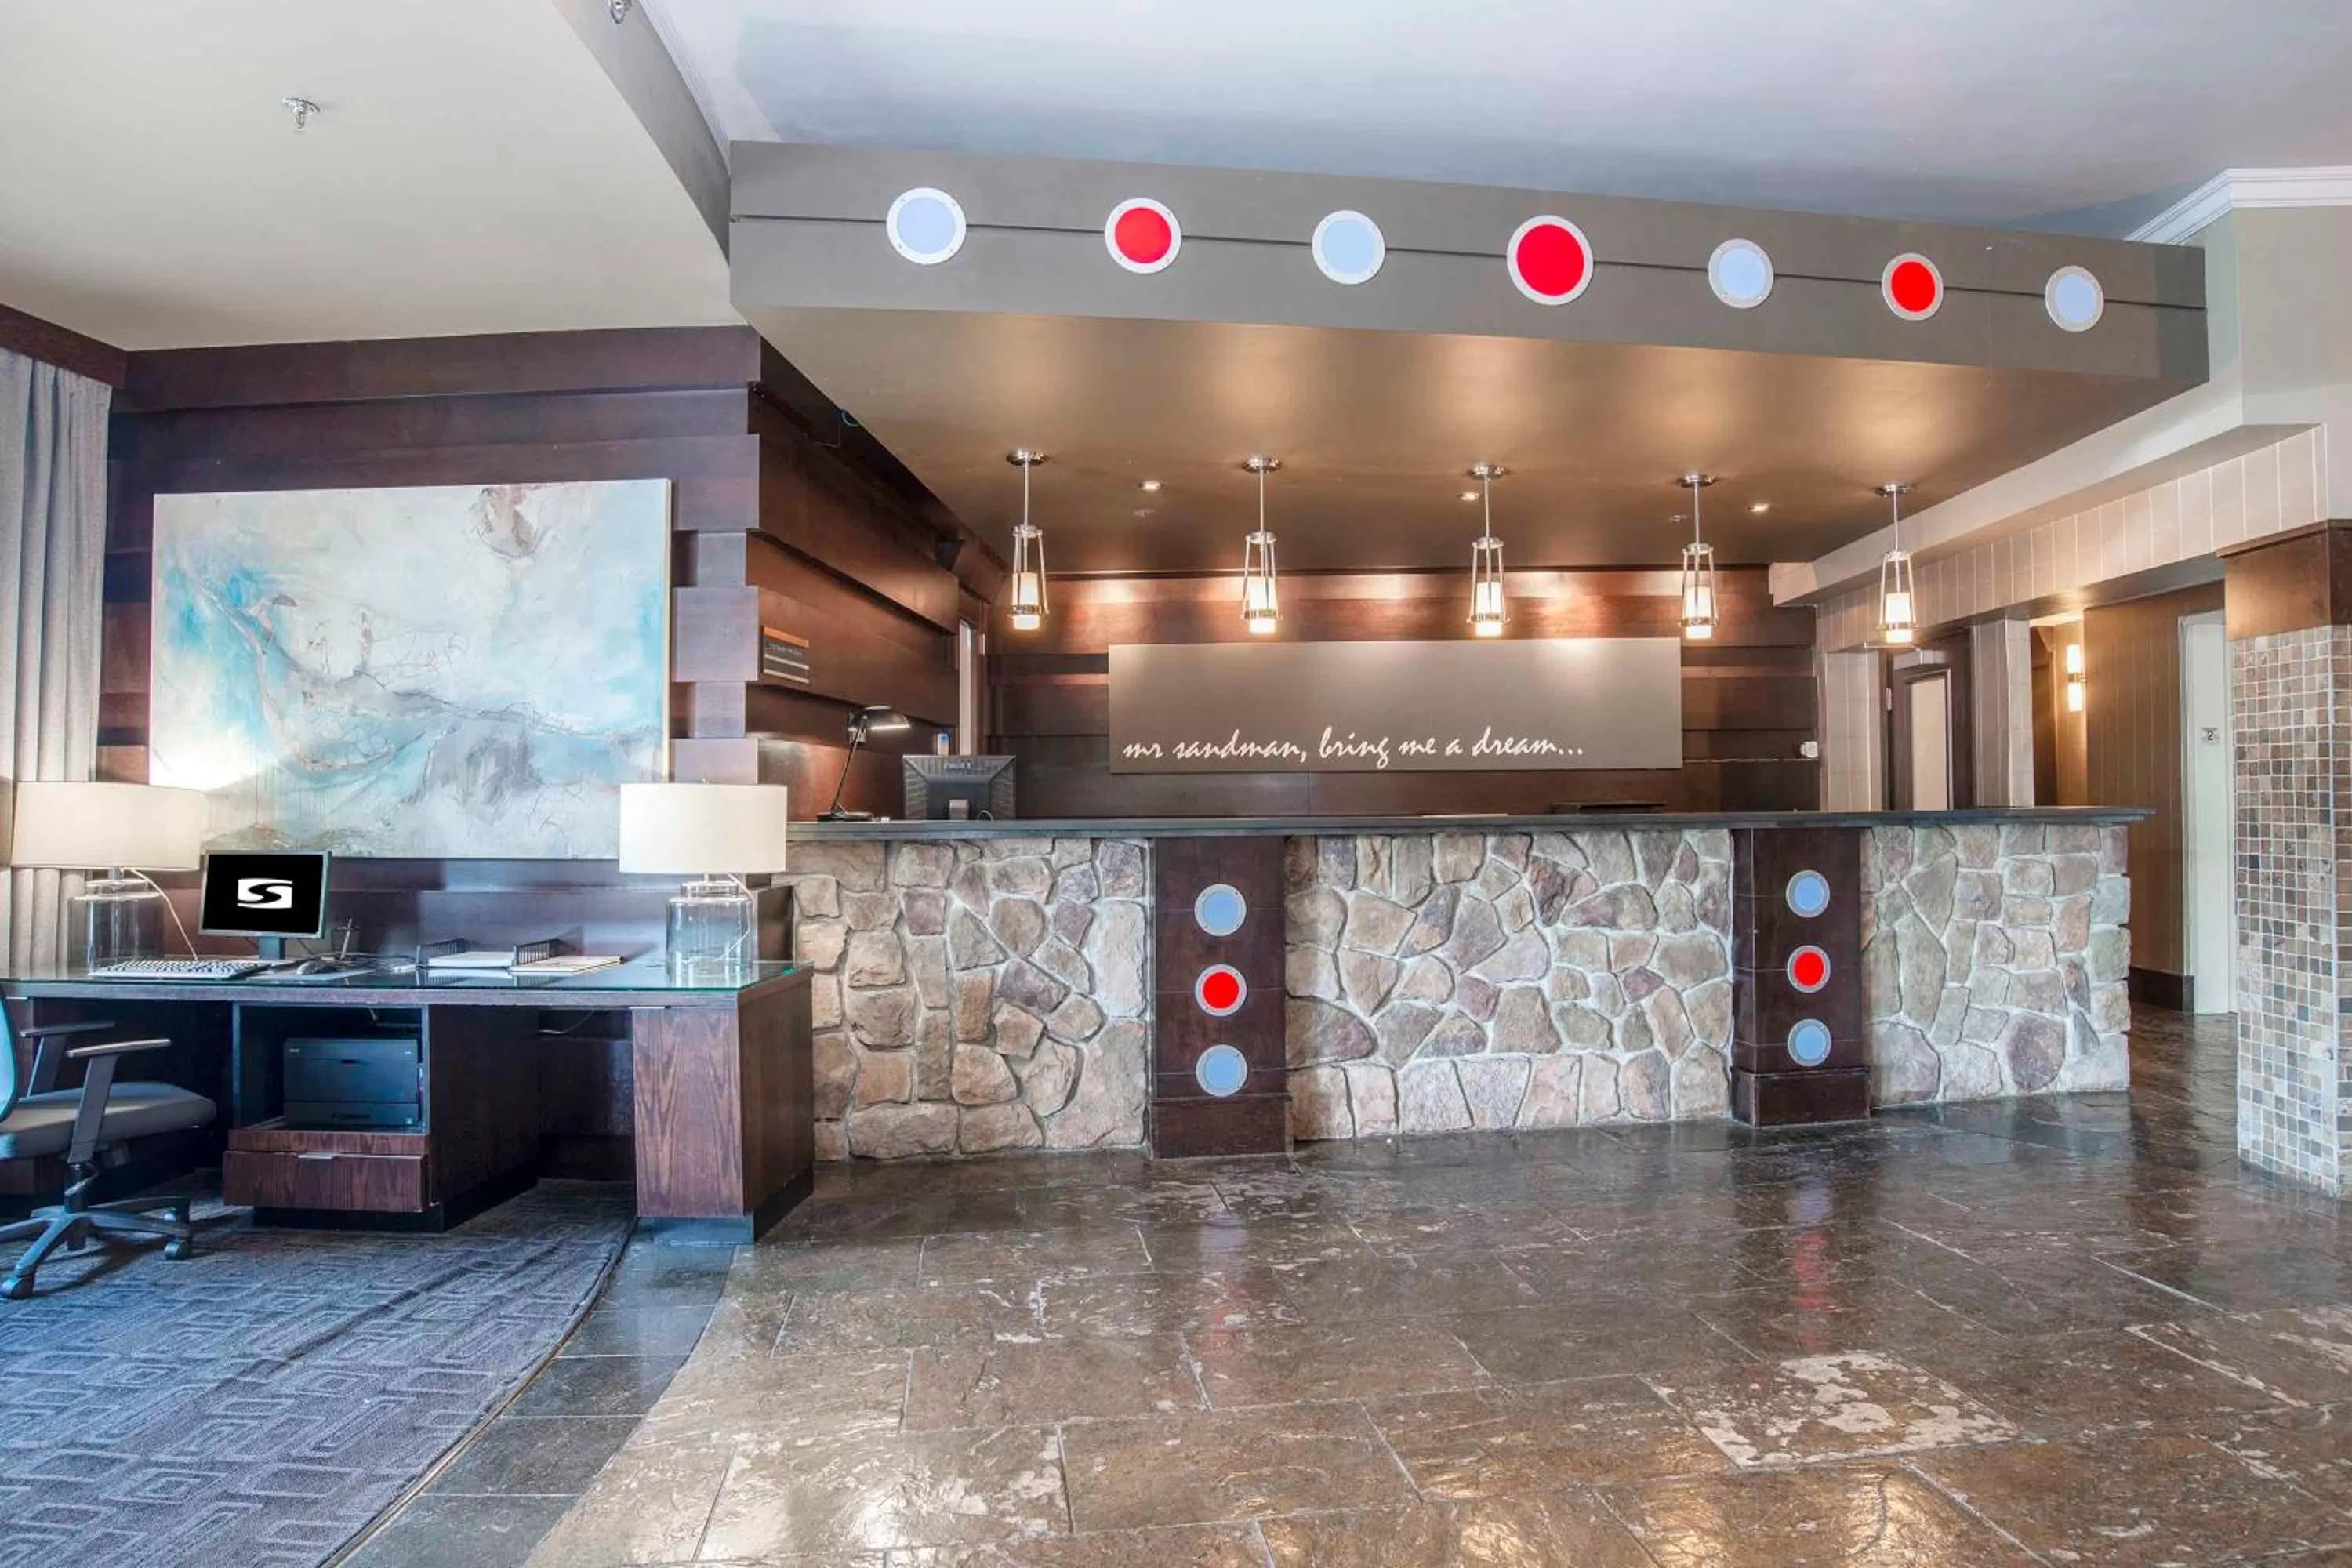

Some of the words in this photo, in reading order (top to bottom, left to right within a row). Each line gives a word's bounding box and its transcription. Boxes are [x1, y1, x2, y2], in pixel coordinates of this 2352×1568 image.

[1122, 742, 1165, 759] mr
[1172, 728, 1308, 764] sandman,
[1318, 725, 1390, 769] bring
[1398, 737, 1437, 757] me
[1444, 738, 1464, 757] a
[1472, 725, 1584, 757] dream...
